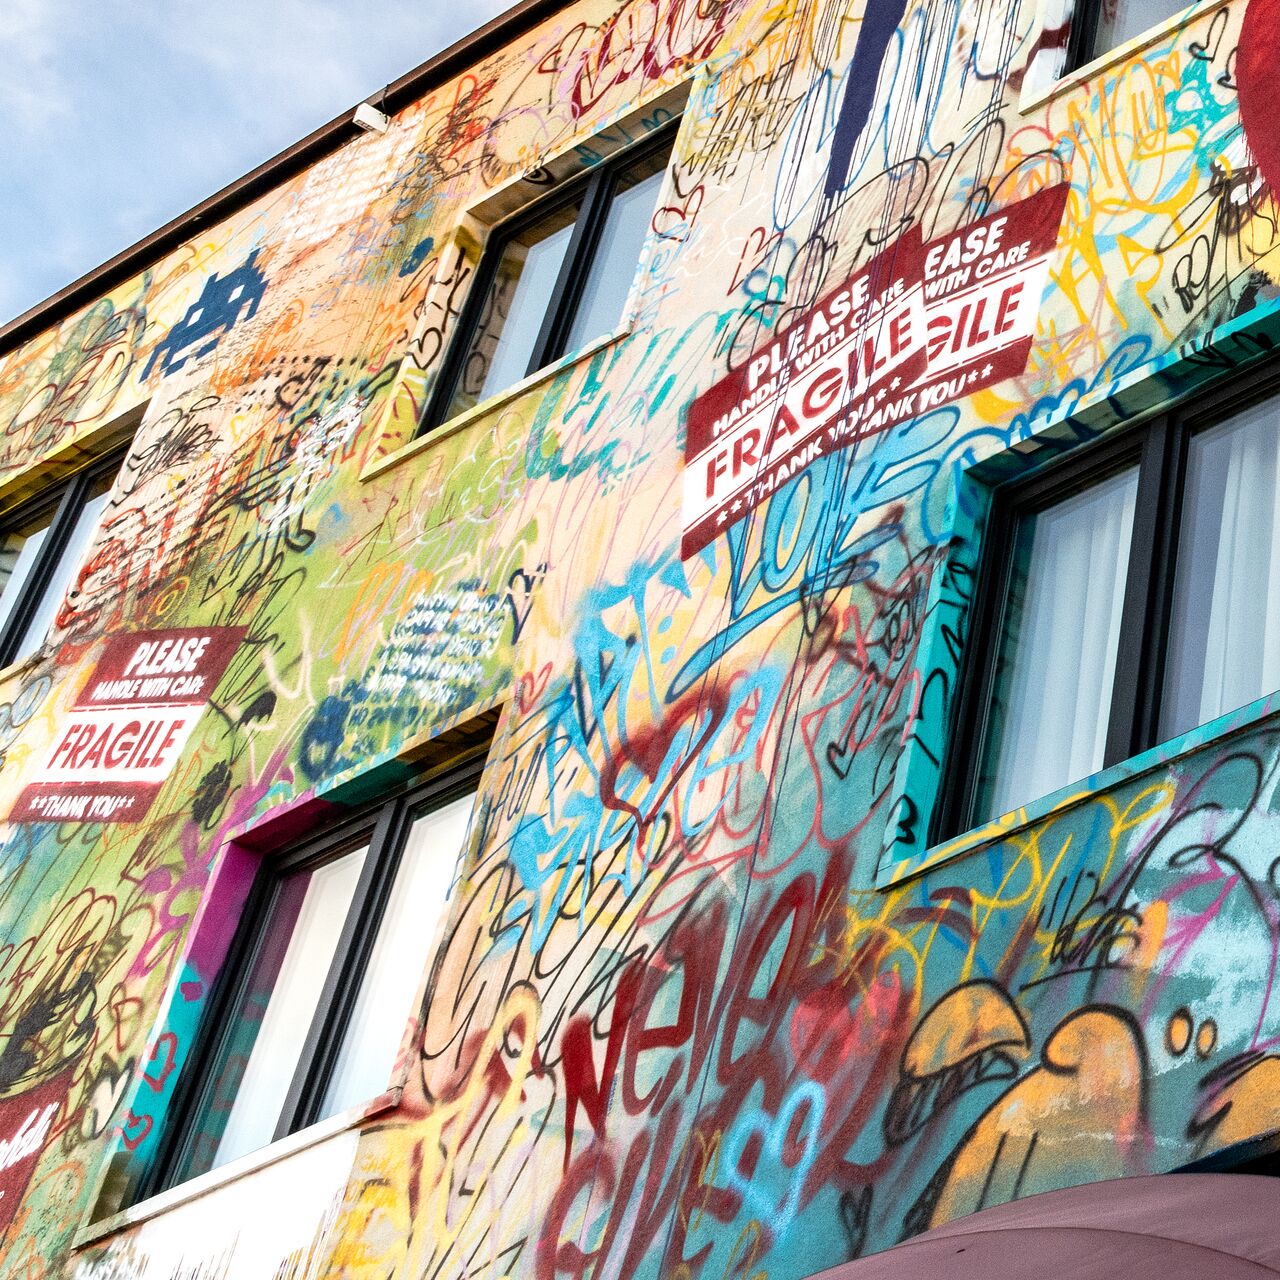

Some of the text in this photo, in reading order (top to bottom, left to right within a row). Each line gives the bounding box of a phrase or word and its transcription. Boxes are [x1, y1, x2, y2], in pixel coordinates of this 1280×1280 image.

[924, 241, 1031, 301] WITH CARE
[711, 278, 905, 439] HANDLE WITH CARE
[749, 273, 870, 393] PLEASE
[705, 312, 915, 500] FRAGILE
[123, 637, 211, 677] PLEASE
[90, 675, 206, 700] HANDLE WITH CARE
[47, 719, 186, 770] FRAGILE
